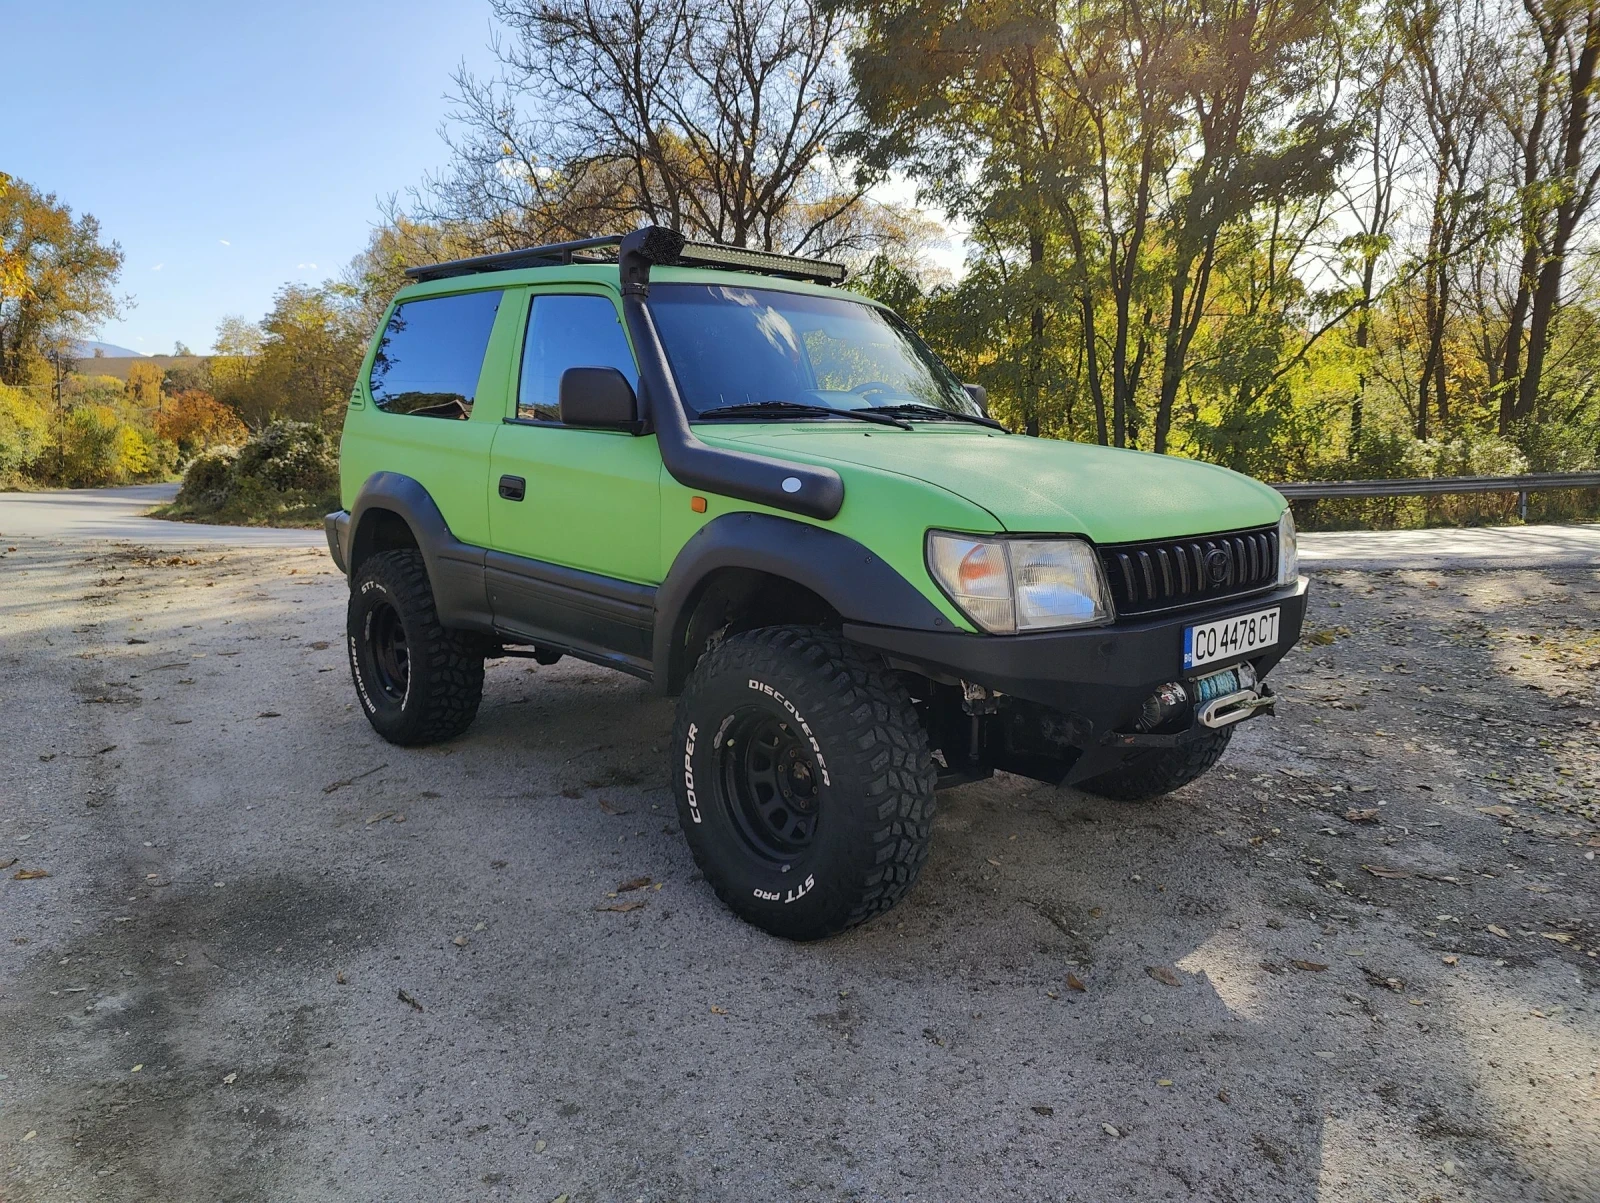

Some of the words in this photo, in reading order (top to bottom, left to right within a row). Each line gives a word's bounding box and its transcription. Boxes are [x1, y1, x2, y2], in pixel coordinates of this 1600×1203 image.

[361, 581, 374, 594] STT
[375, 583, 387, 594] PRO
[1195, 627, 1217, 660] CO
[1220, 618, 1256, 653] 4478
[1259, 612, 1277, 643] CT
[351, 636, 377, 714] DISCOVERER
[1184, 652, 1192, 663] BG
[748, 678, 831, 787] DISCOVERER
[684, 722, 702, 824] COOPER
[753, 888, 780, 901] PRO
[784, 873, 815, 904] STT
